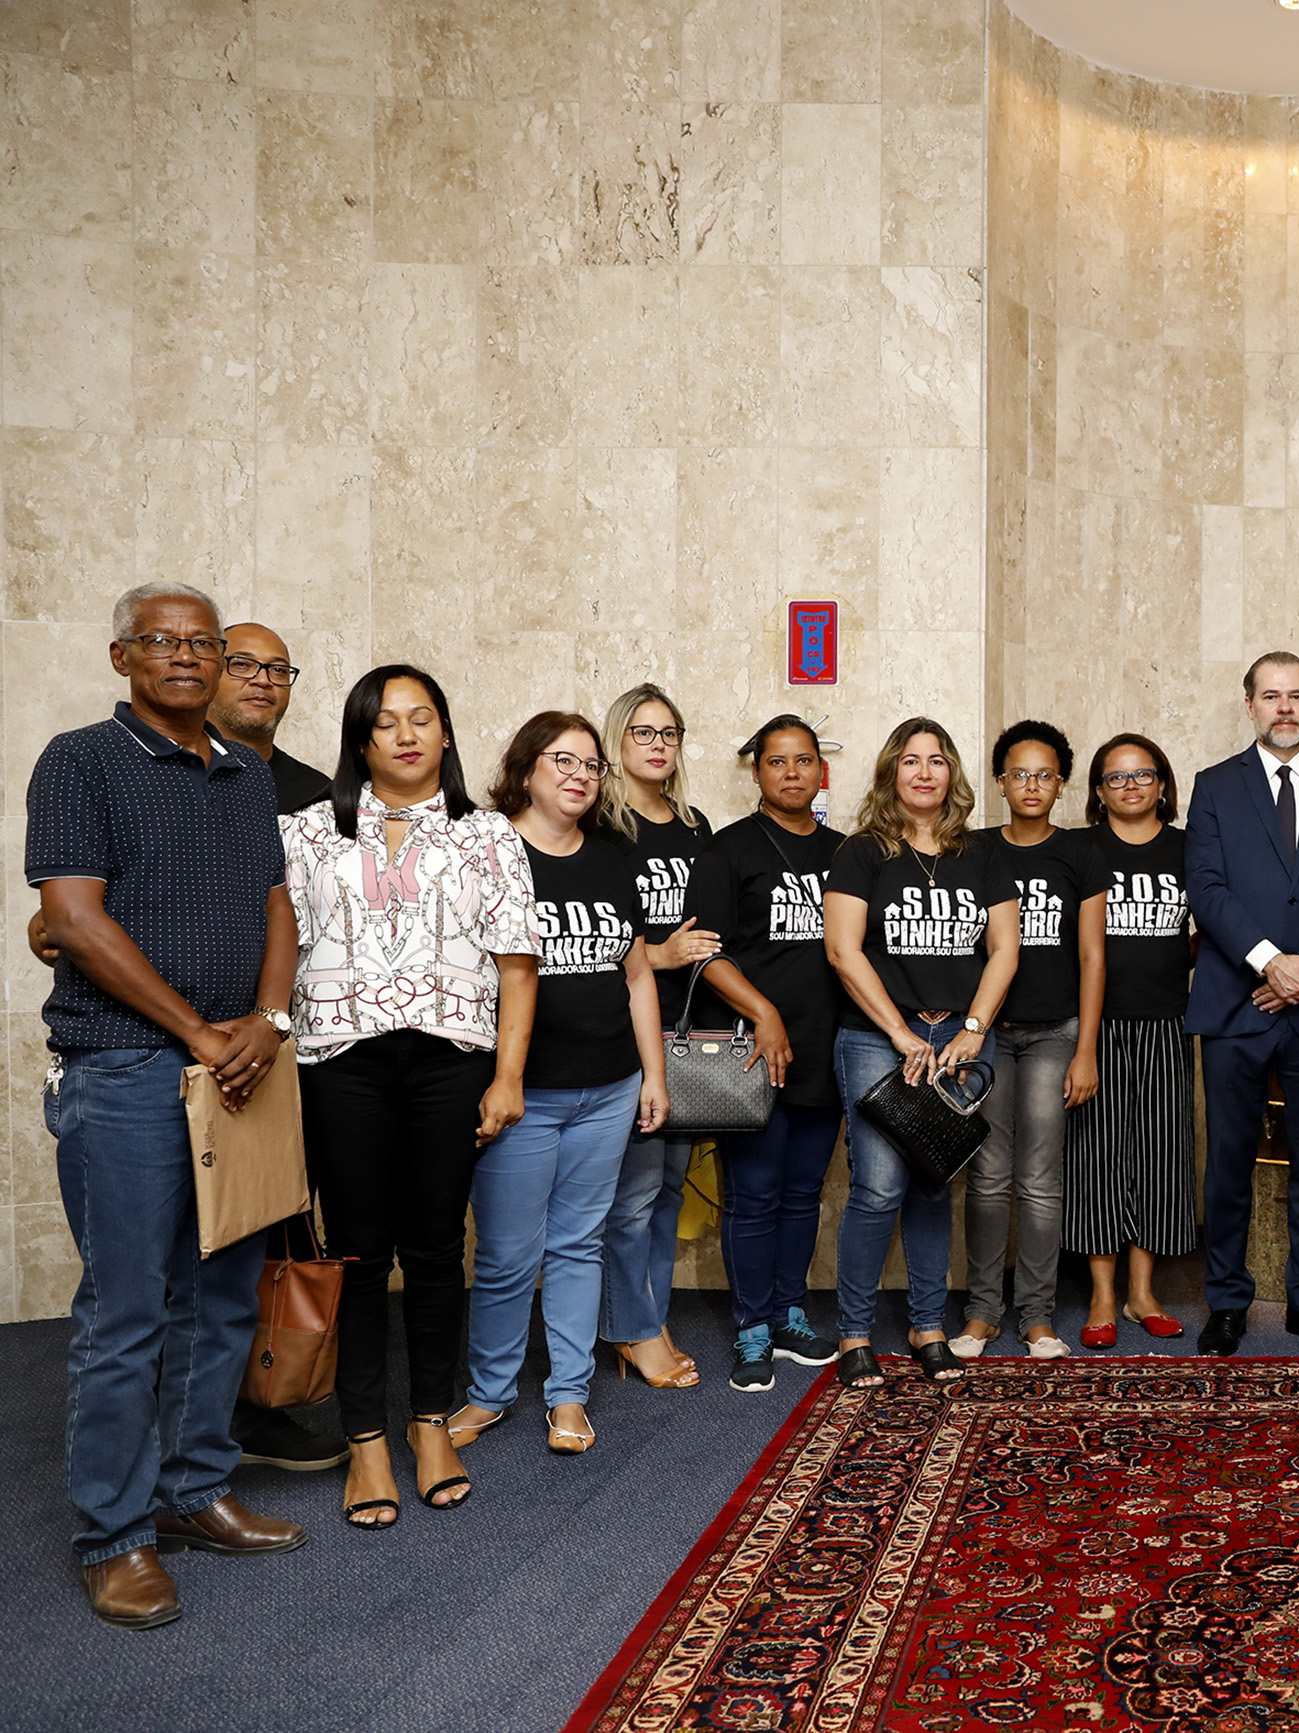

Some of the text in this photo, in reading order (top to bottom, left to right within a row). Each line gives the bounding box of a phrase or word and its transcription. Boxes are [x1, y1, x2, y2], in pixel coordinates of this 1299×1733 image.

[903, 887, 977, 922] S.O.S
[536, 901, 620, 937] S.O.S
[769, 932, 784, 941] SOU
[884, 920, 985, 948] PINHEIRO
[1139, 927, 1153, 936] SOU
[887, 946, 900, 954] SOU
[936, 947, 951, 956] SOU
[578, 964, 595, 973] SOU
